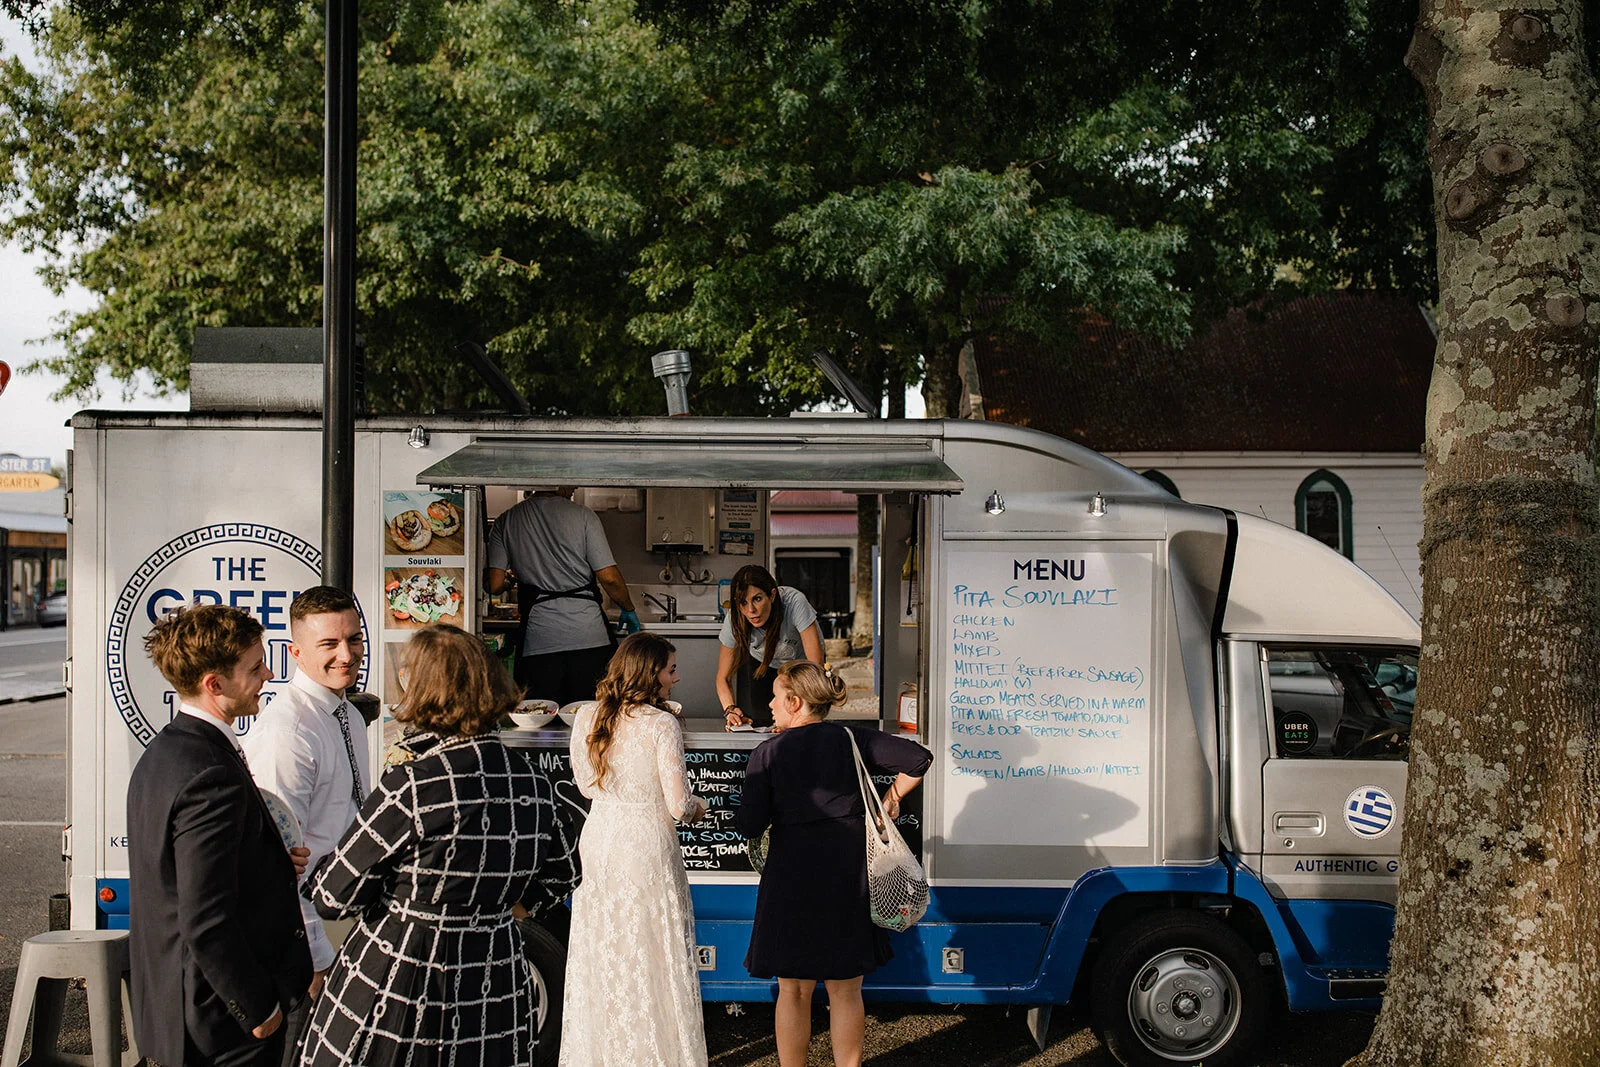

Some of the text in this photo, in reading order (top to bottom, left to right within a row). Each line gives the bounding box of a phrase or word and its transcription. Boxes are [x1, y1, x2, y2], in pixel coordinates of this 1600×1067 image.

[0, 458, 46, 471] STER ST
[408, 557, 442, 565] Souvlaki
[212, 557, 266, 581] THE
[1013, 559, 1085, 580] MENU
[953, 584, 1118, 608] PITA SOUVLAKI
[952, 614, 1015, 626] CHICKEN
[953, 628, 999, 641] LAMB
[953, 642, 1001, 657] MIXED
[1013, 677, 1032, 689] (V)
[950, 690, 1145, 710] GRILLED MEATS SERVED IN A WARM
[951, 705, 975, 720] PITA
[977, 708, 1004, 721] WITH
[1007, 709, 1049, 721] FRESH
[952, 720, 985, 735] FRIES
[998, 725, 1021, 735] OUR
[1077, 728, 1122, 738] SAUCE
[1284, 731, 1308, 739] EATS
[951, 743, 1002, 760] SALADS
[700, 830, 748, 842] SOUV
[711, 843, 749, 856] TOMA
[1294, 860, 1378, 873] AUTHENTIC
